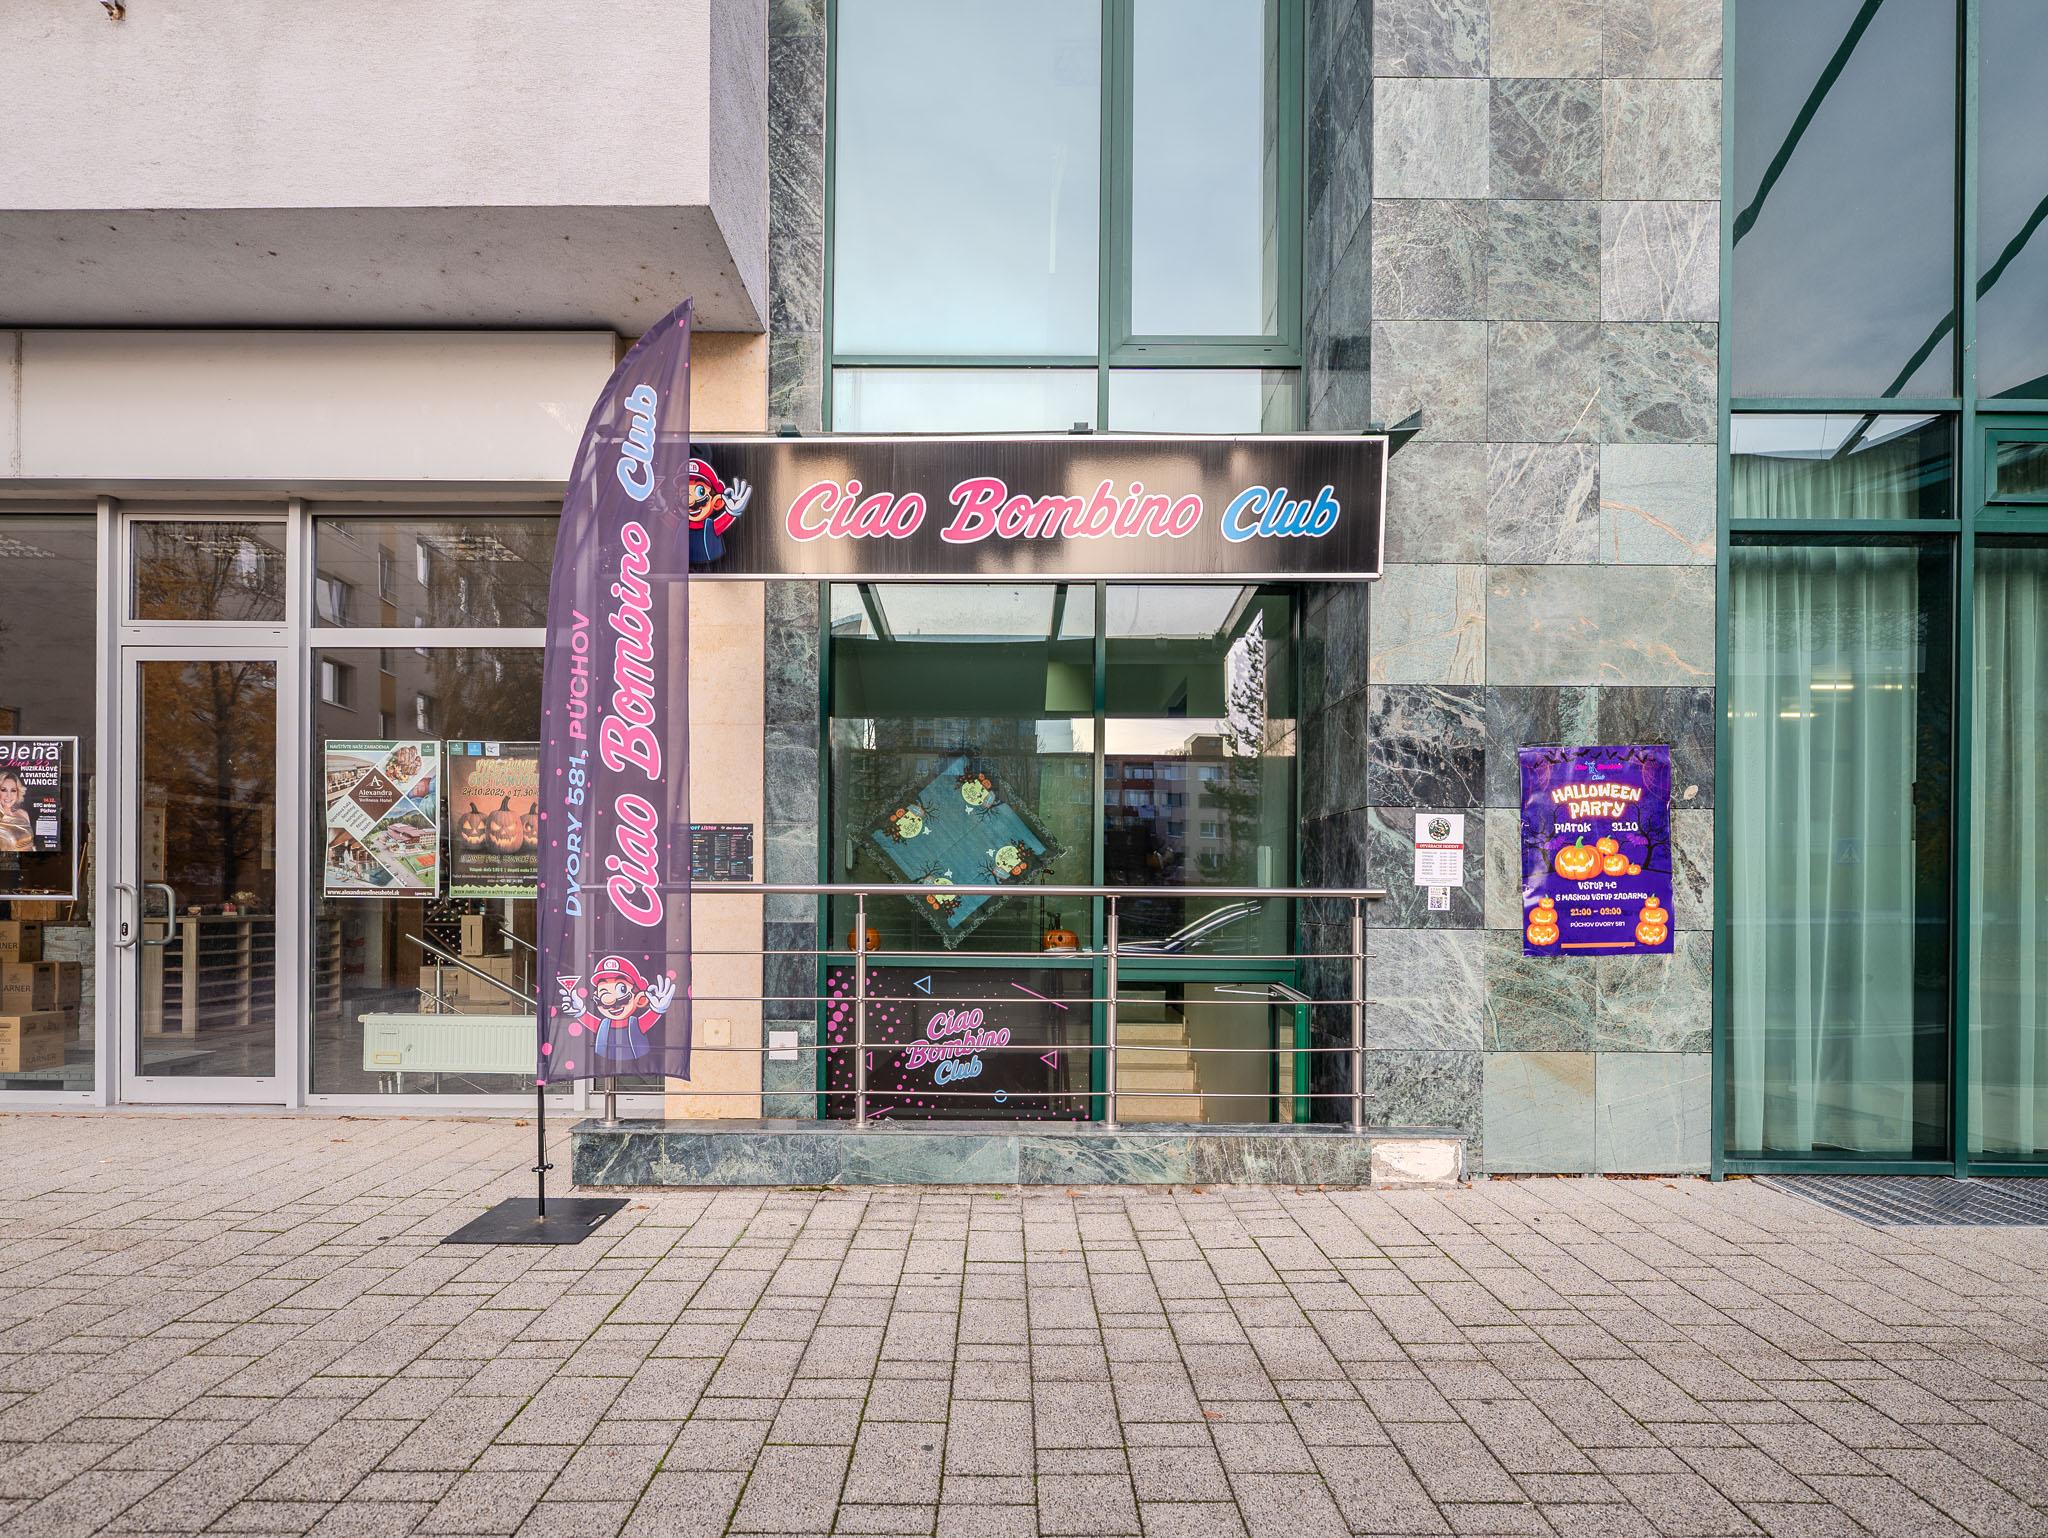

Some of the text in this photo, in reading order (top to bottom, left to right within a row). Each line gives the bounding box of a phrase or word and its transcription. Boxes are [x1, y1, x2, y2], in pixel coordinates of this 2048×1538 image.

[786, 477, 1341, 543] Ciao Bombino Club
[599, 383, 664, 928] Ciao Bombino Club
[0, 741, 59, 760] elena
[566, 609, 590, 916] DVORY 581, PÚCHOV
[1552, 783, 1641, 803] HALLOWEEN
[1569, 801, 1625, 819] PARTY
[1554, 822, 1638, 833] PIATOK 31.10
[1578, 882, 1603, 890] VSTUP
[1591, 893, 1612, 901] VSTUP
[1570, 908, 1592, 916] 21:00
[1600, 907, 1621, 915] 03:00
[3, 984, 31, 992] ARNER
[927, 1008, 984, 1040] Ciao
[905, 1027, 1011, 1069] Bombino
[934, 1056, 983, 1085] Club
